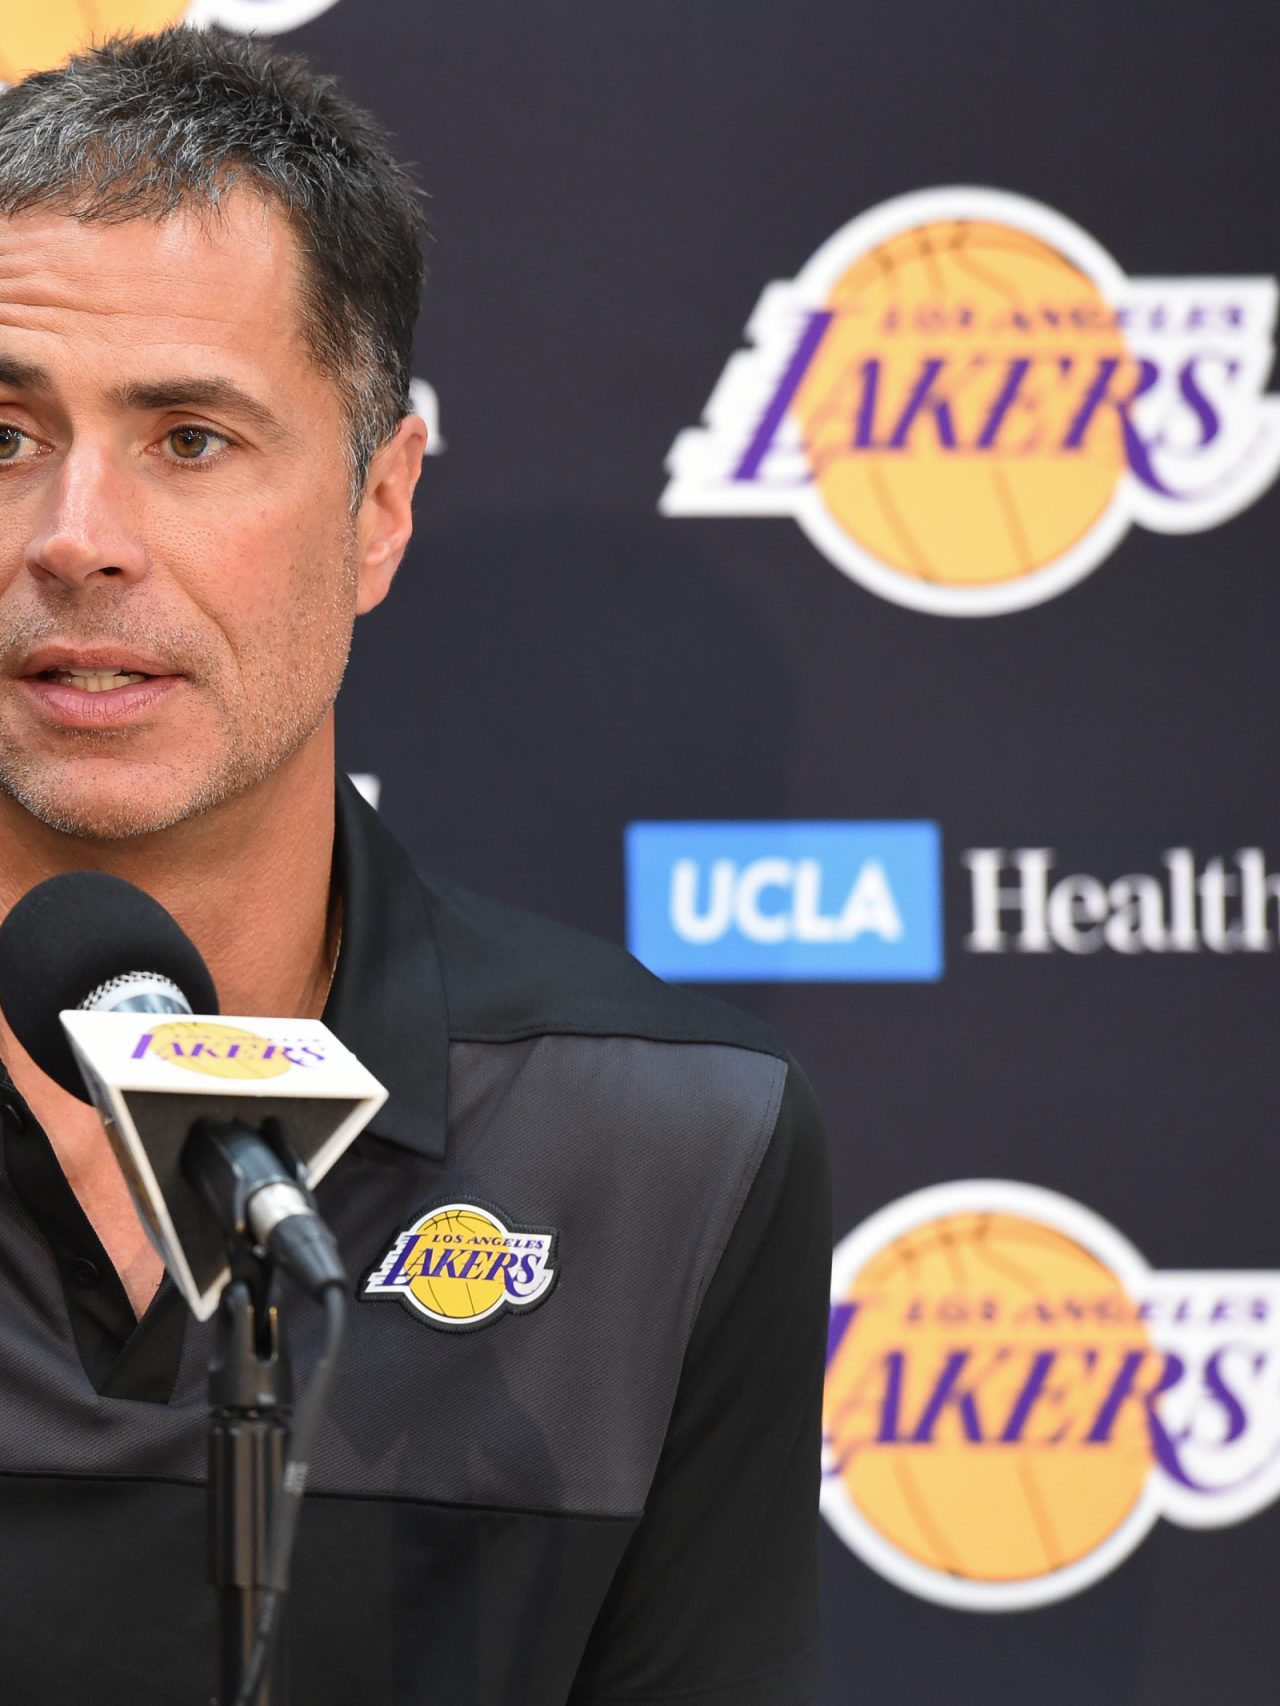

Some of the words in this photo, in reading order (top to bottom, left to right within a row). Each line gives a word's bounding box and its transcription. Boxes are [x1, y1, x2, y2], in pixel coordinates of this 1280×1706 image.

[725, 308, 1248, 501] LAKERS
[668, 855, 905, 945] UCLA
[375, 1234, 544, 1297] LAKERS
[431, 1234, 463, 1244] LOS
[466, 1235, 545, 1249] ANGELES
